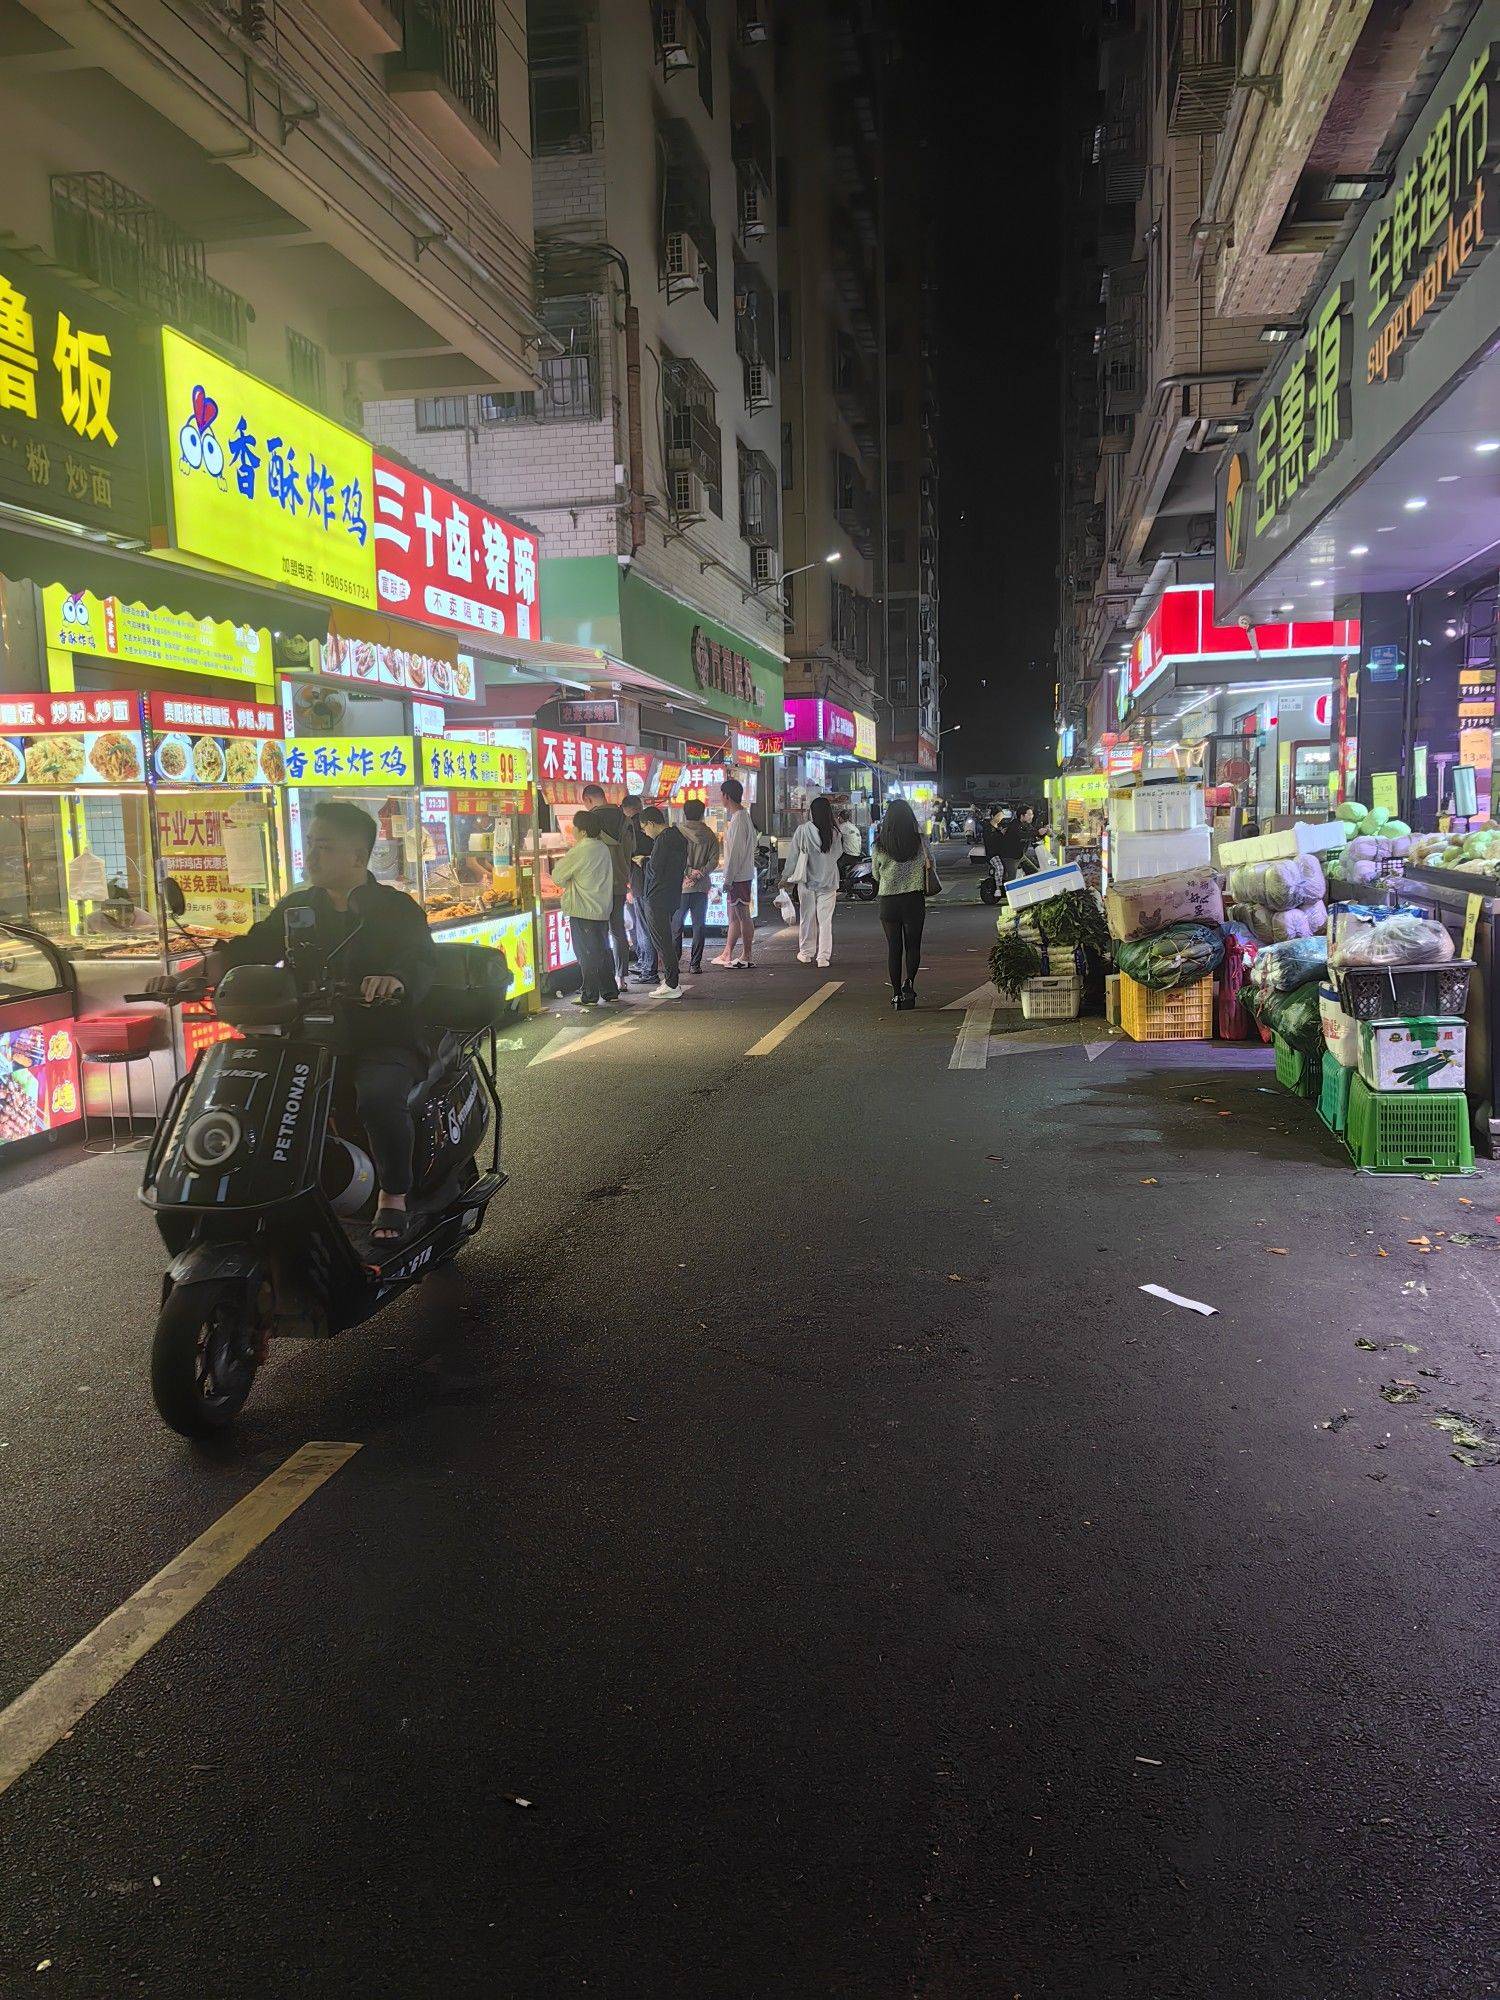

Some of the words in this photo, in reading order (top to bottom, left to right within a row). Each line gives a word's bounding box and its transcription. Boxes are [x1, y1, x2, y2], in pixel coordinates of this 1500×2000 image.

[1367, 48, 1490, 328] 生鲜超市
[1367, 176, 1485, 385] supermarket
[228, 415, 367, 547] 香酥炸鸡
[284, 745, 408, 780] 香酥炸鸡
[542, 736, 624, 784] 不卖隔夜菜
[157, 810, 234, 847] 开业大酬
[272, 1063, 311, 1163] PETRONAS
